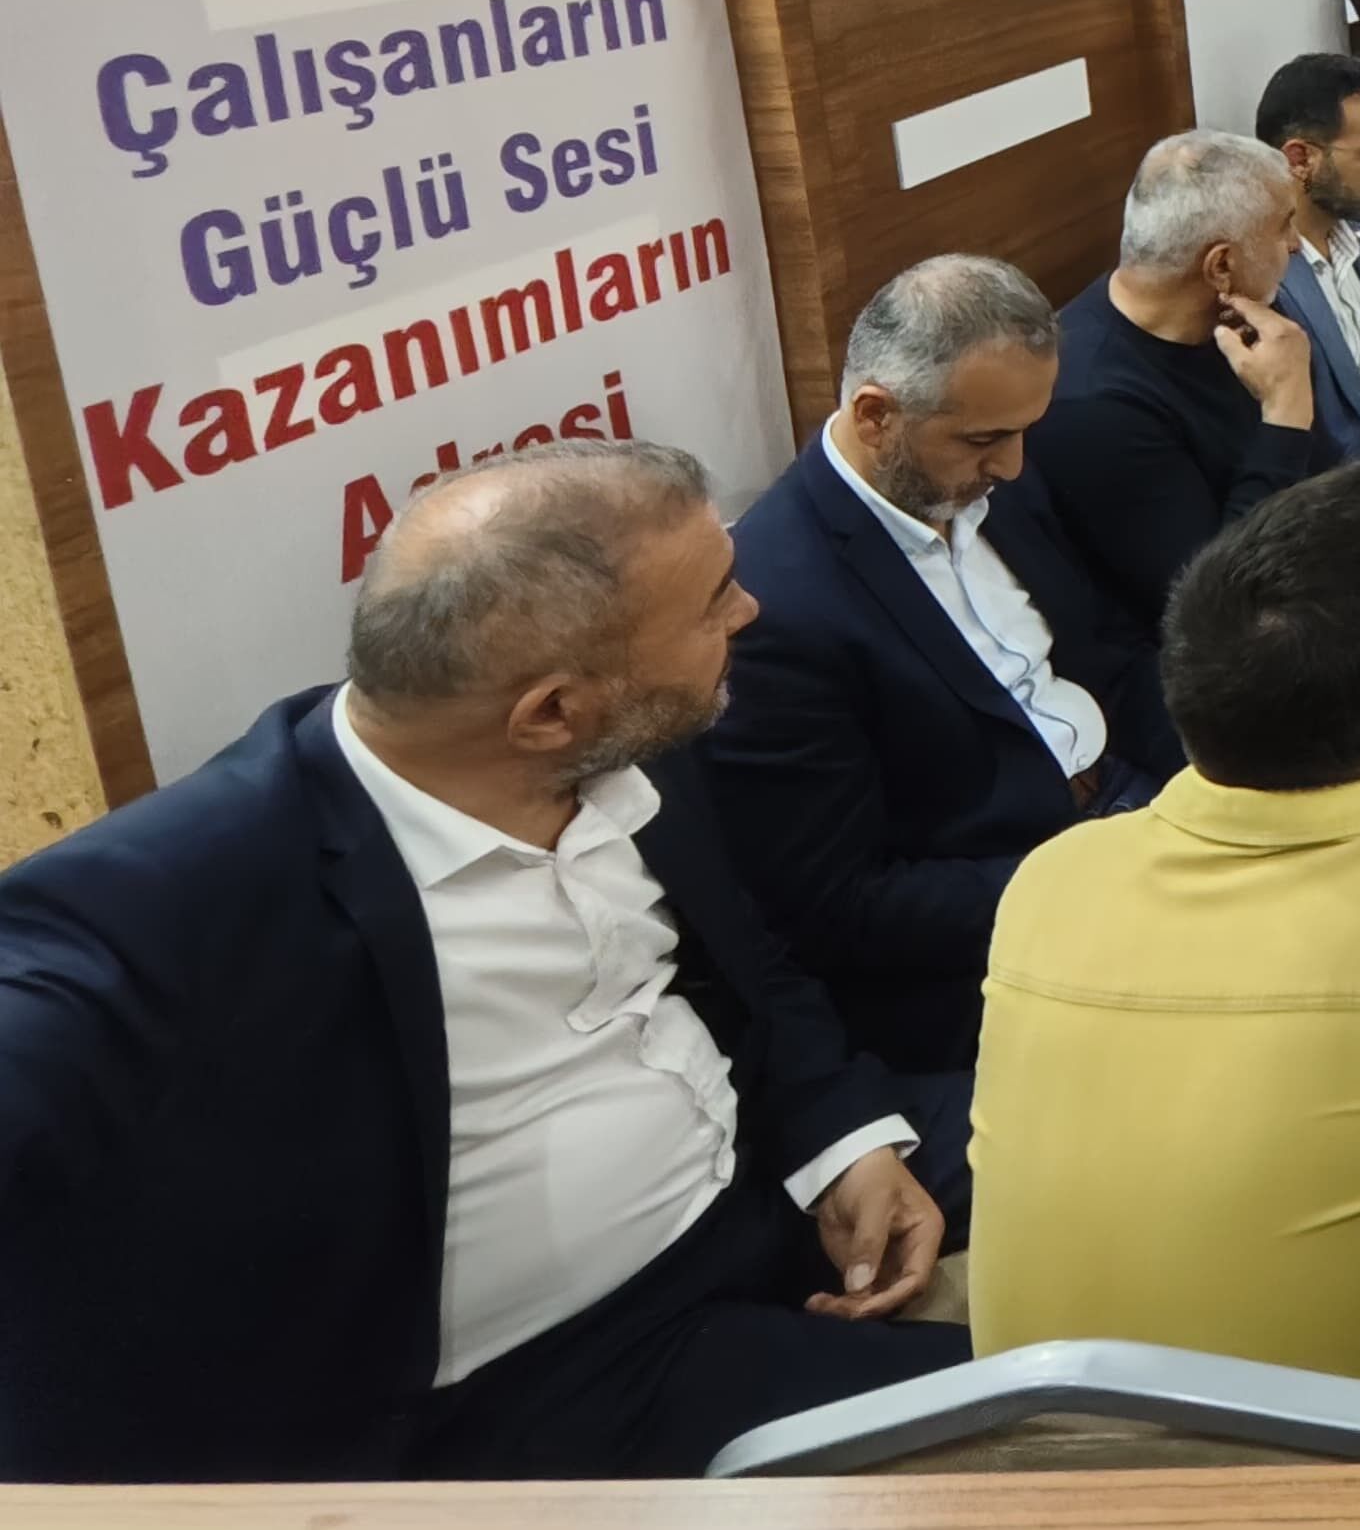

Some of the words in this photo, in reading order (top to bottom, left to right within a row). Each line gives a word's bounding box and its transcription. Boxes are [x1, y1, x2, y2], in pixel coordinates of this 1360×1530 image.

[180, 152, 471, 306] Güçlü
[499, 103, 659, 213] Sesi
[82, 217, 731, 510] Kazanımların
